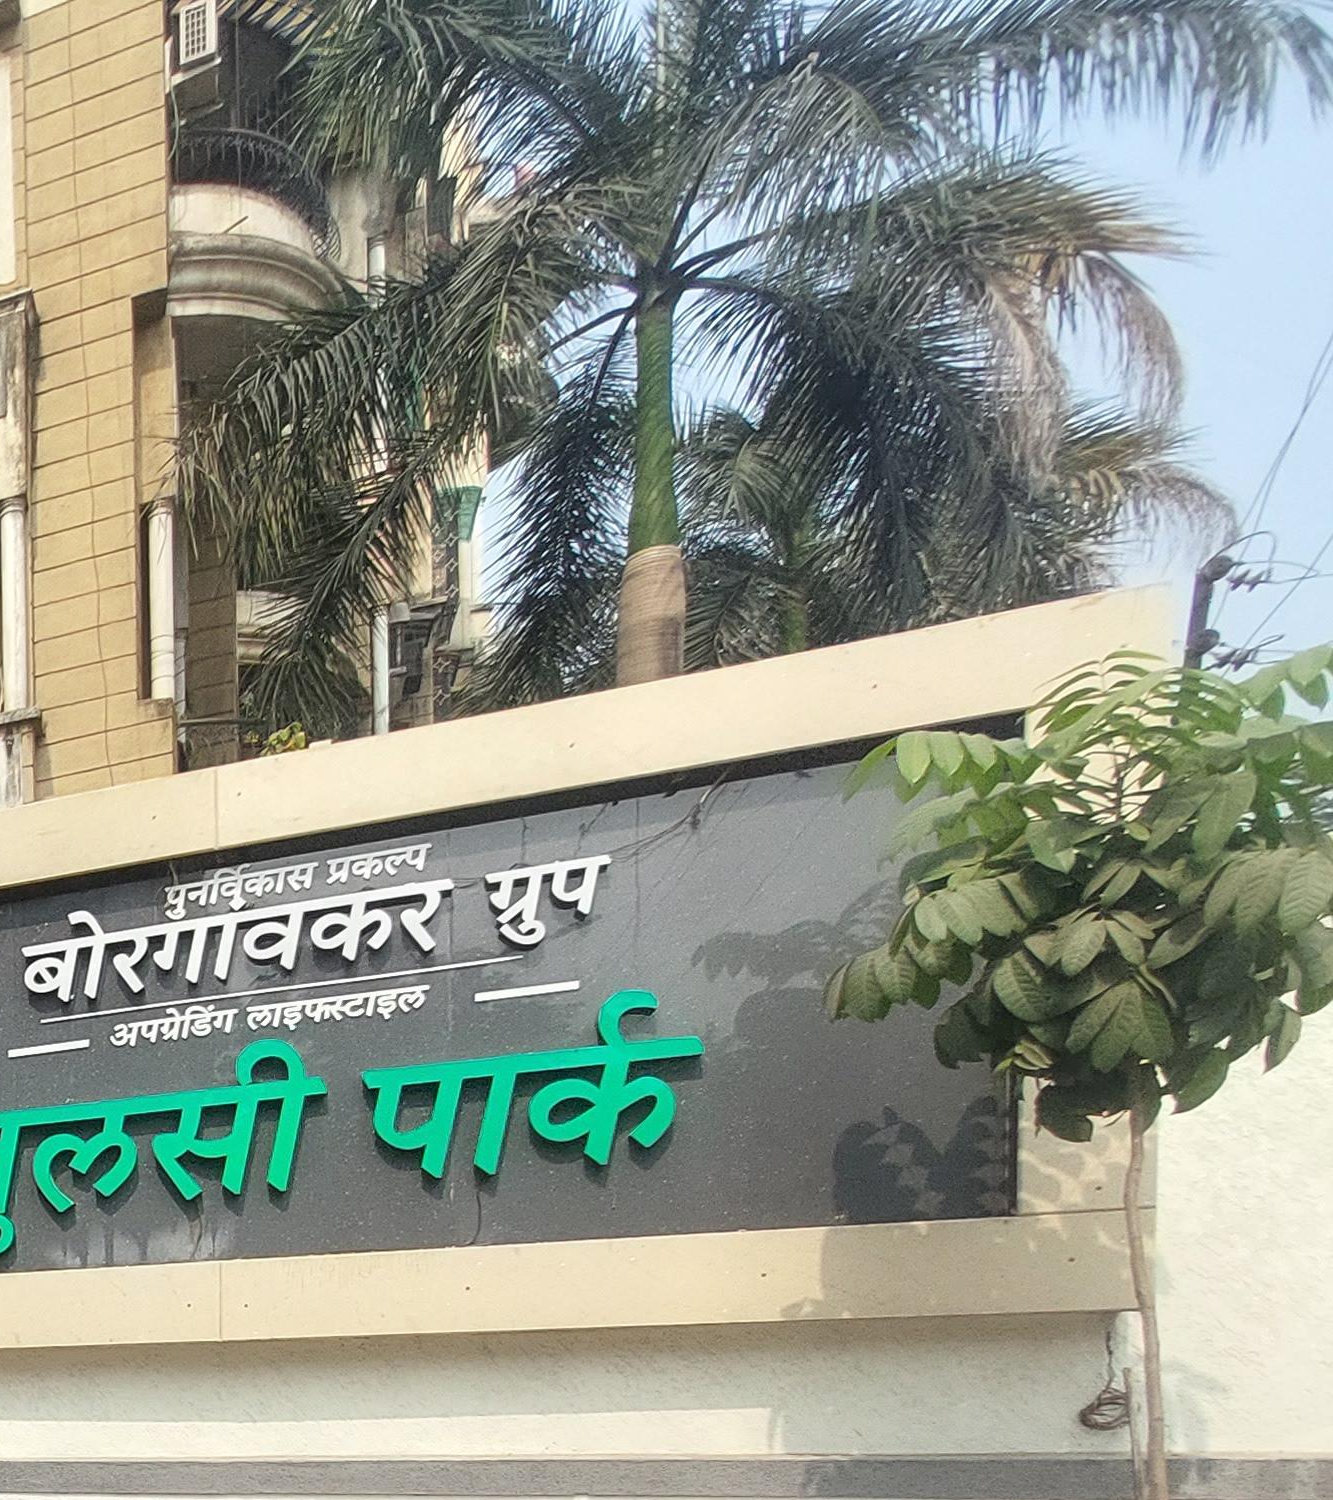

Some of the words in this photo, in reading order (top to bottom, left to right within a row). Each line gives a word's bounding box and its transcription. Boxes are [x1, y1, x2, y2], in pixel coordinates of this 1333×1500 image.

[164, 861, 319, 920] पुनर्विकास
[326, 843, 432, 884] प्रकल्प
[485, 854, 612, 945] ग्रुप
[109, 1005, 239, 1047] अपग्रेडिंग
[246, 984, 431, 1031] लाइफस्टाइल
[362, 989, 704, 1180] पार्क
